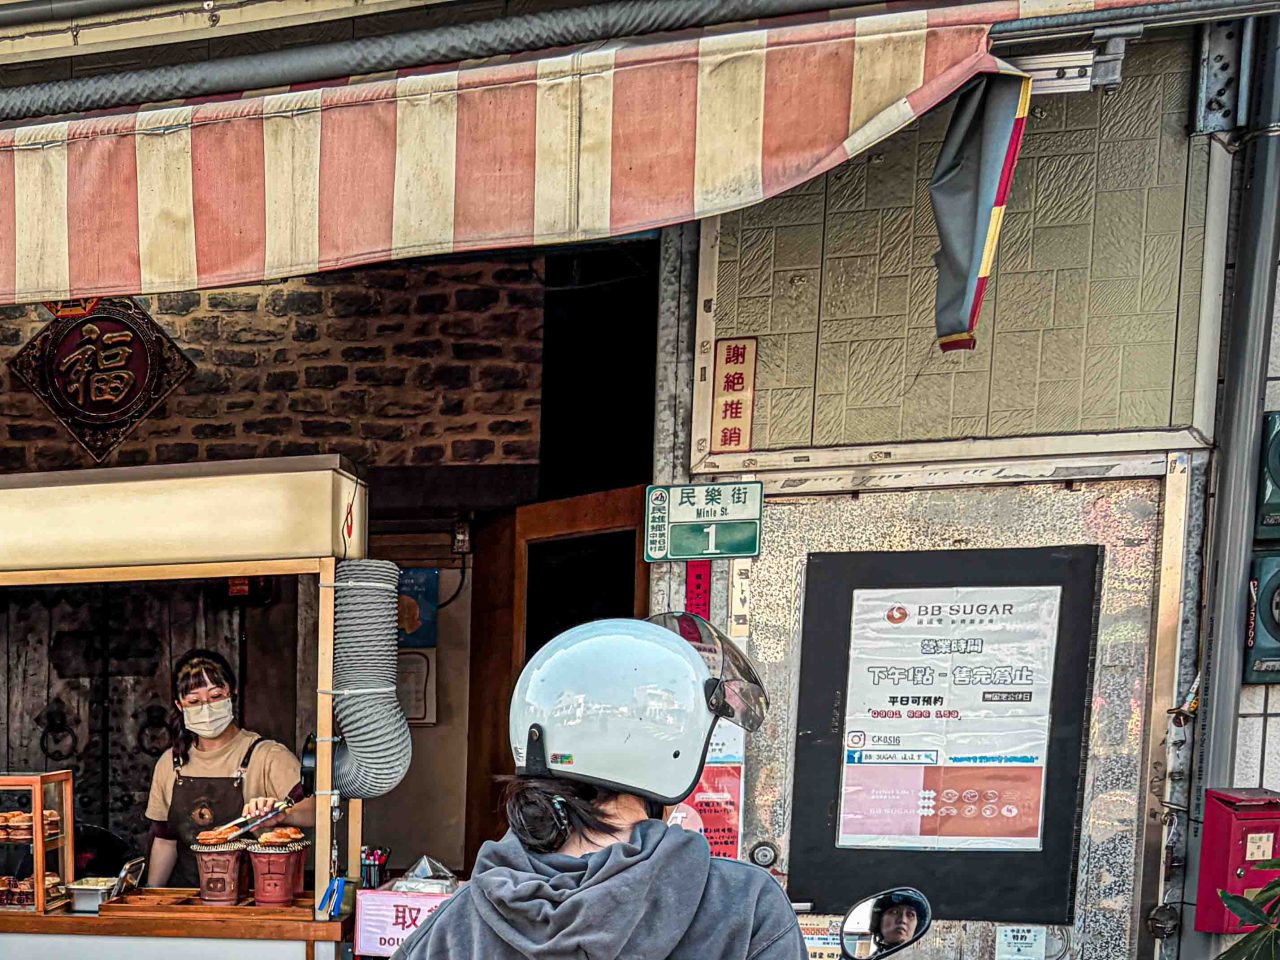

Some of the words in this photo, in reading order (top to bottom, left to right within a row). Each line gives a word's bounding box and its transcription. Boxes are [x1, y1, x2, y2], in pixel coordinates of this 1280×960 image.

[59, 323, 135, 405] 福
[678, 487, 747, 506] 民樂街
[696, 508, 717, 518] Minle
[720, 507, 729, 516] St.
[702, 524, 720, 554] 1
[917, 605, 942, 616] BB
[948, 603, 1014, 616] SUGAR
[920, 638, 984, 655] 營業時間
[868, 666, 935, 687] 下午1點
[888, 696, 944, 707] 平日可預約
